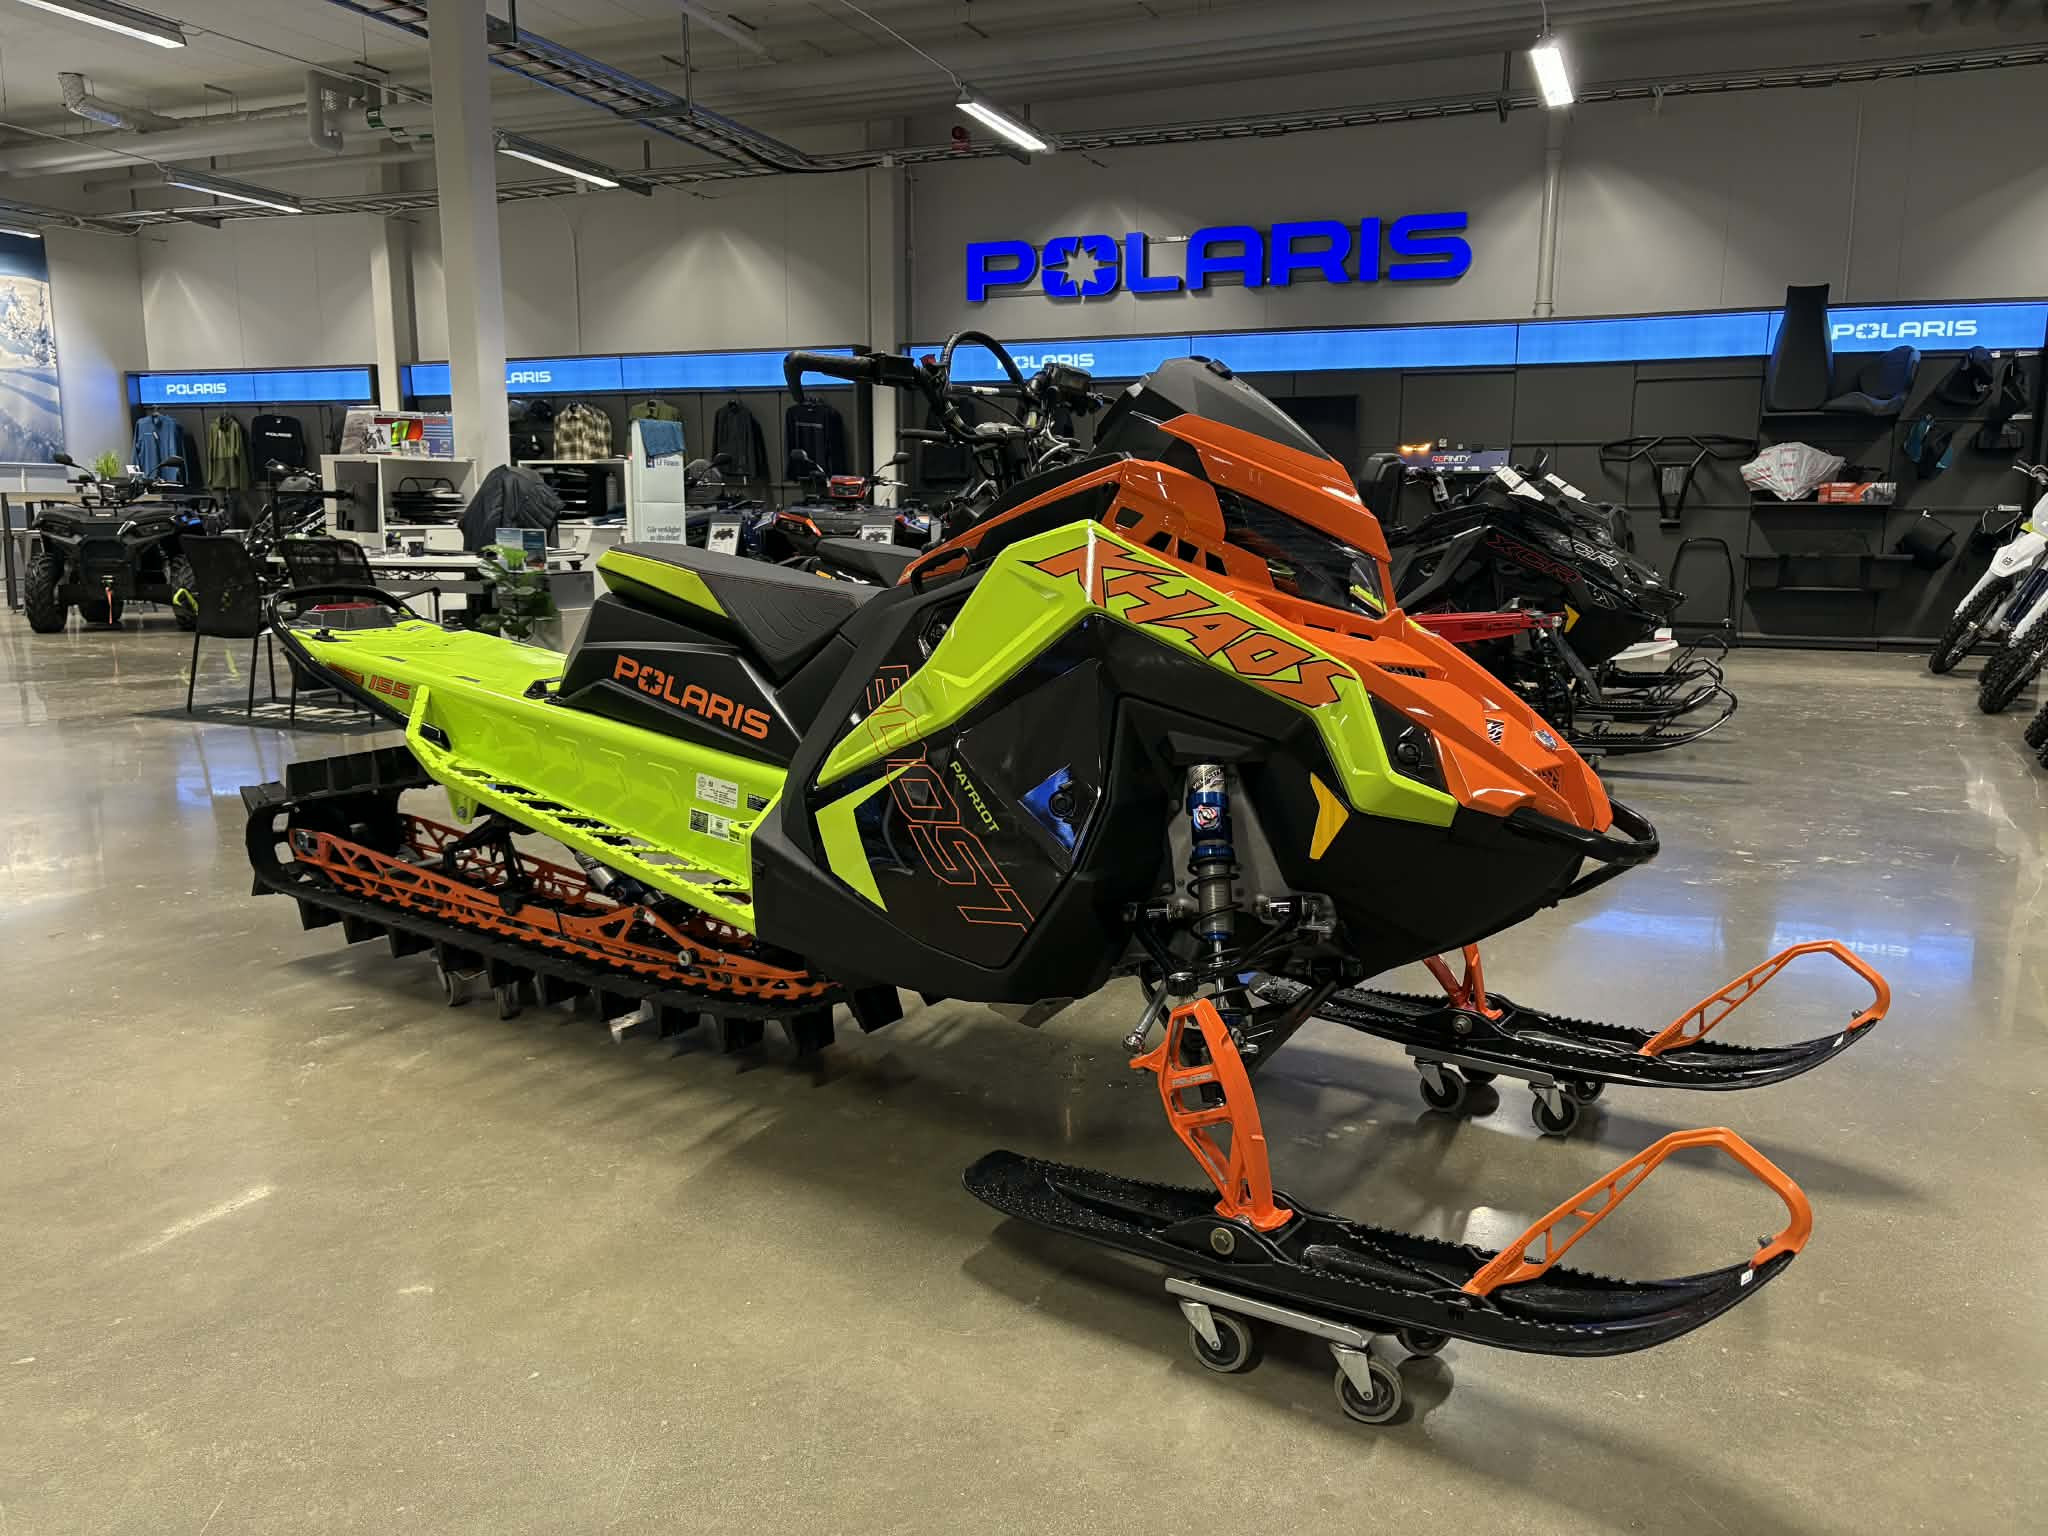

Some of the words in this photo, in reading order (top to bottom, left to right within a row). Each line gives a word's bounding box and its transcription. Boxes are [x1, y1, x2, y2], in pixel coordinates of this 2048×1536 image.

[967, 212, 1473, 302] POLARIS
[1831, 319, 1978, 341] POLARIS
[505, 370, 552, 384] ARIS
[996, 352, 1095, 370] OLARIS
[166, 382, 228, 395] POLARIS
[1487, 533, 1583, 585] XCR
[1018, 534, 1357, 709] KHAOS
[368, 673, 412, 701] 155
[613, 654, 772, 741] POLARIS
[949, 760, 1001, 832] PATRIOT
